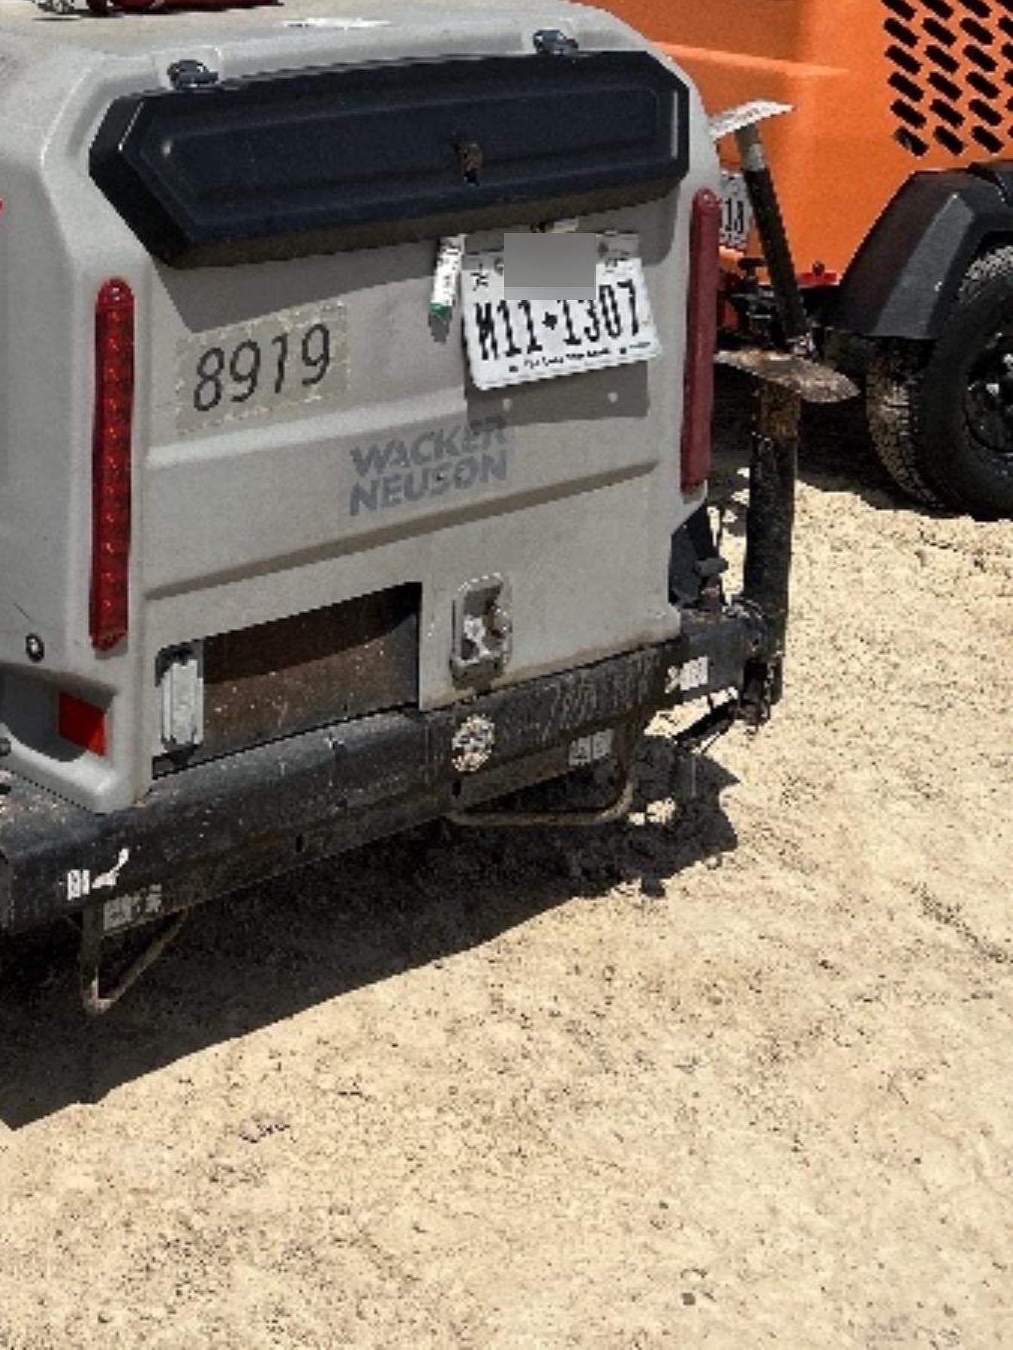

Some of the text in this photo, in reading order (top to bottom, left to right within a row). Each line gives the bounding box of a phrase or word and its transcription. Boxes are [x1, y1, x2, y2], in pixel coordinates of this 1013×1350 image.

[193, 323, 330, 412] 8919
[349, 412, 507, 478] WACKER
[349, 449, 508, 517] NEUSON
